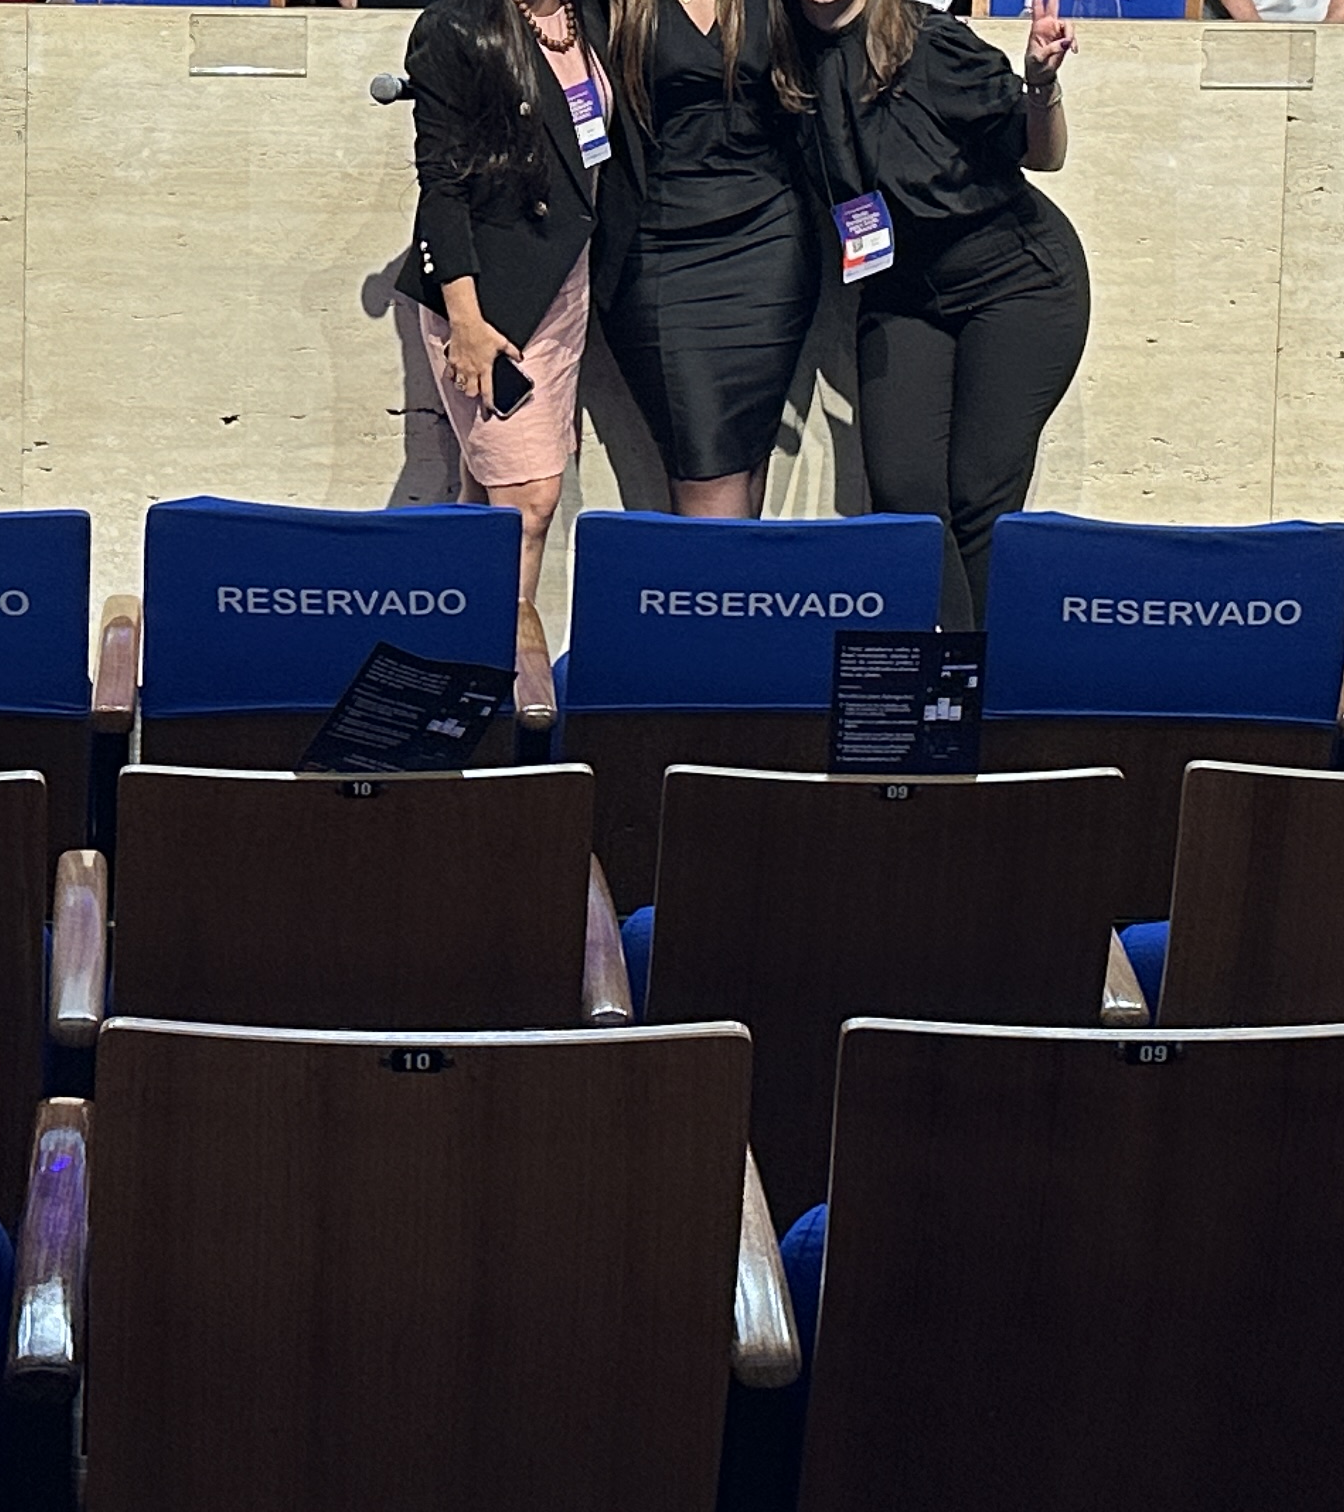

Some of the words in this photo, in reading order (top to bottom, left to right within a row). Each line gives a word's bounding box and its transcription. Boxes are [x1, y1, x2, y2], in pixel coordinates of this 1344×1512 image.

[219, 587, 465, 615] RESERVADO
[641, 590, 883, 617] RESERVADO
[1064, 598, 1301, 625] RESERVADO
[353, 781, 372, 795] 10
[887, 785, 908, 799] 09
[402, 1052, 431, 1070] 10
[1139, 1045, 1168, 1063] 09
